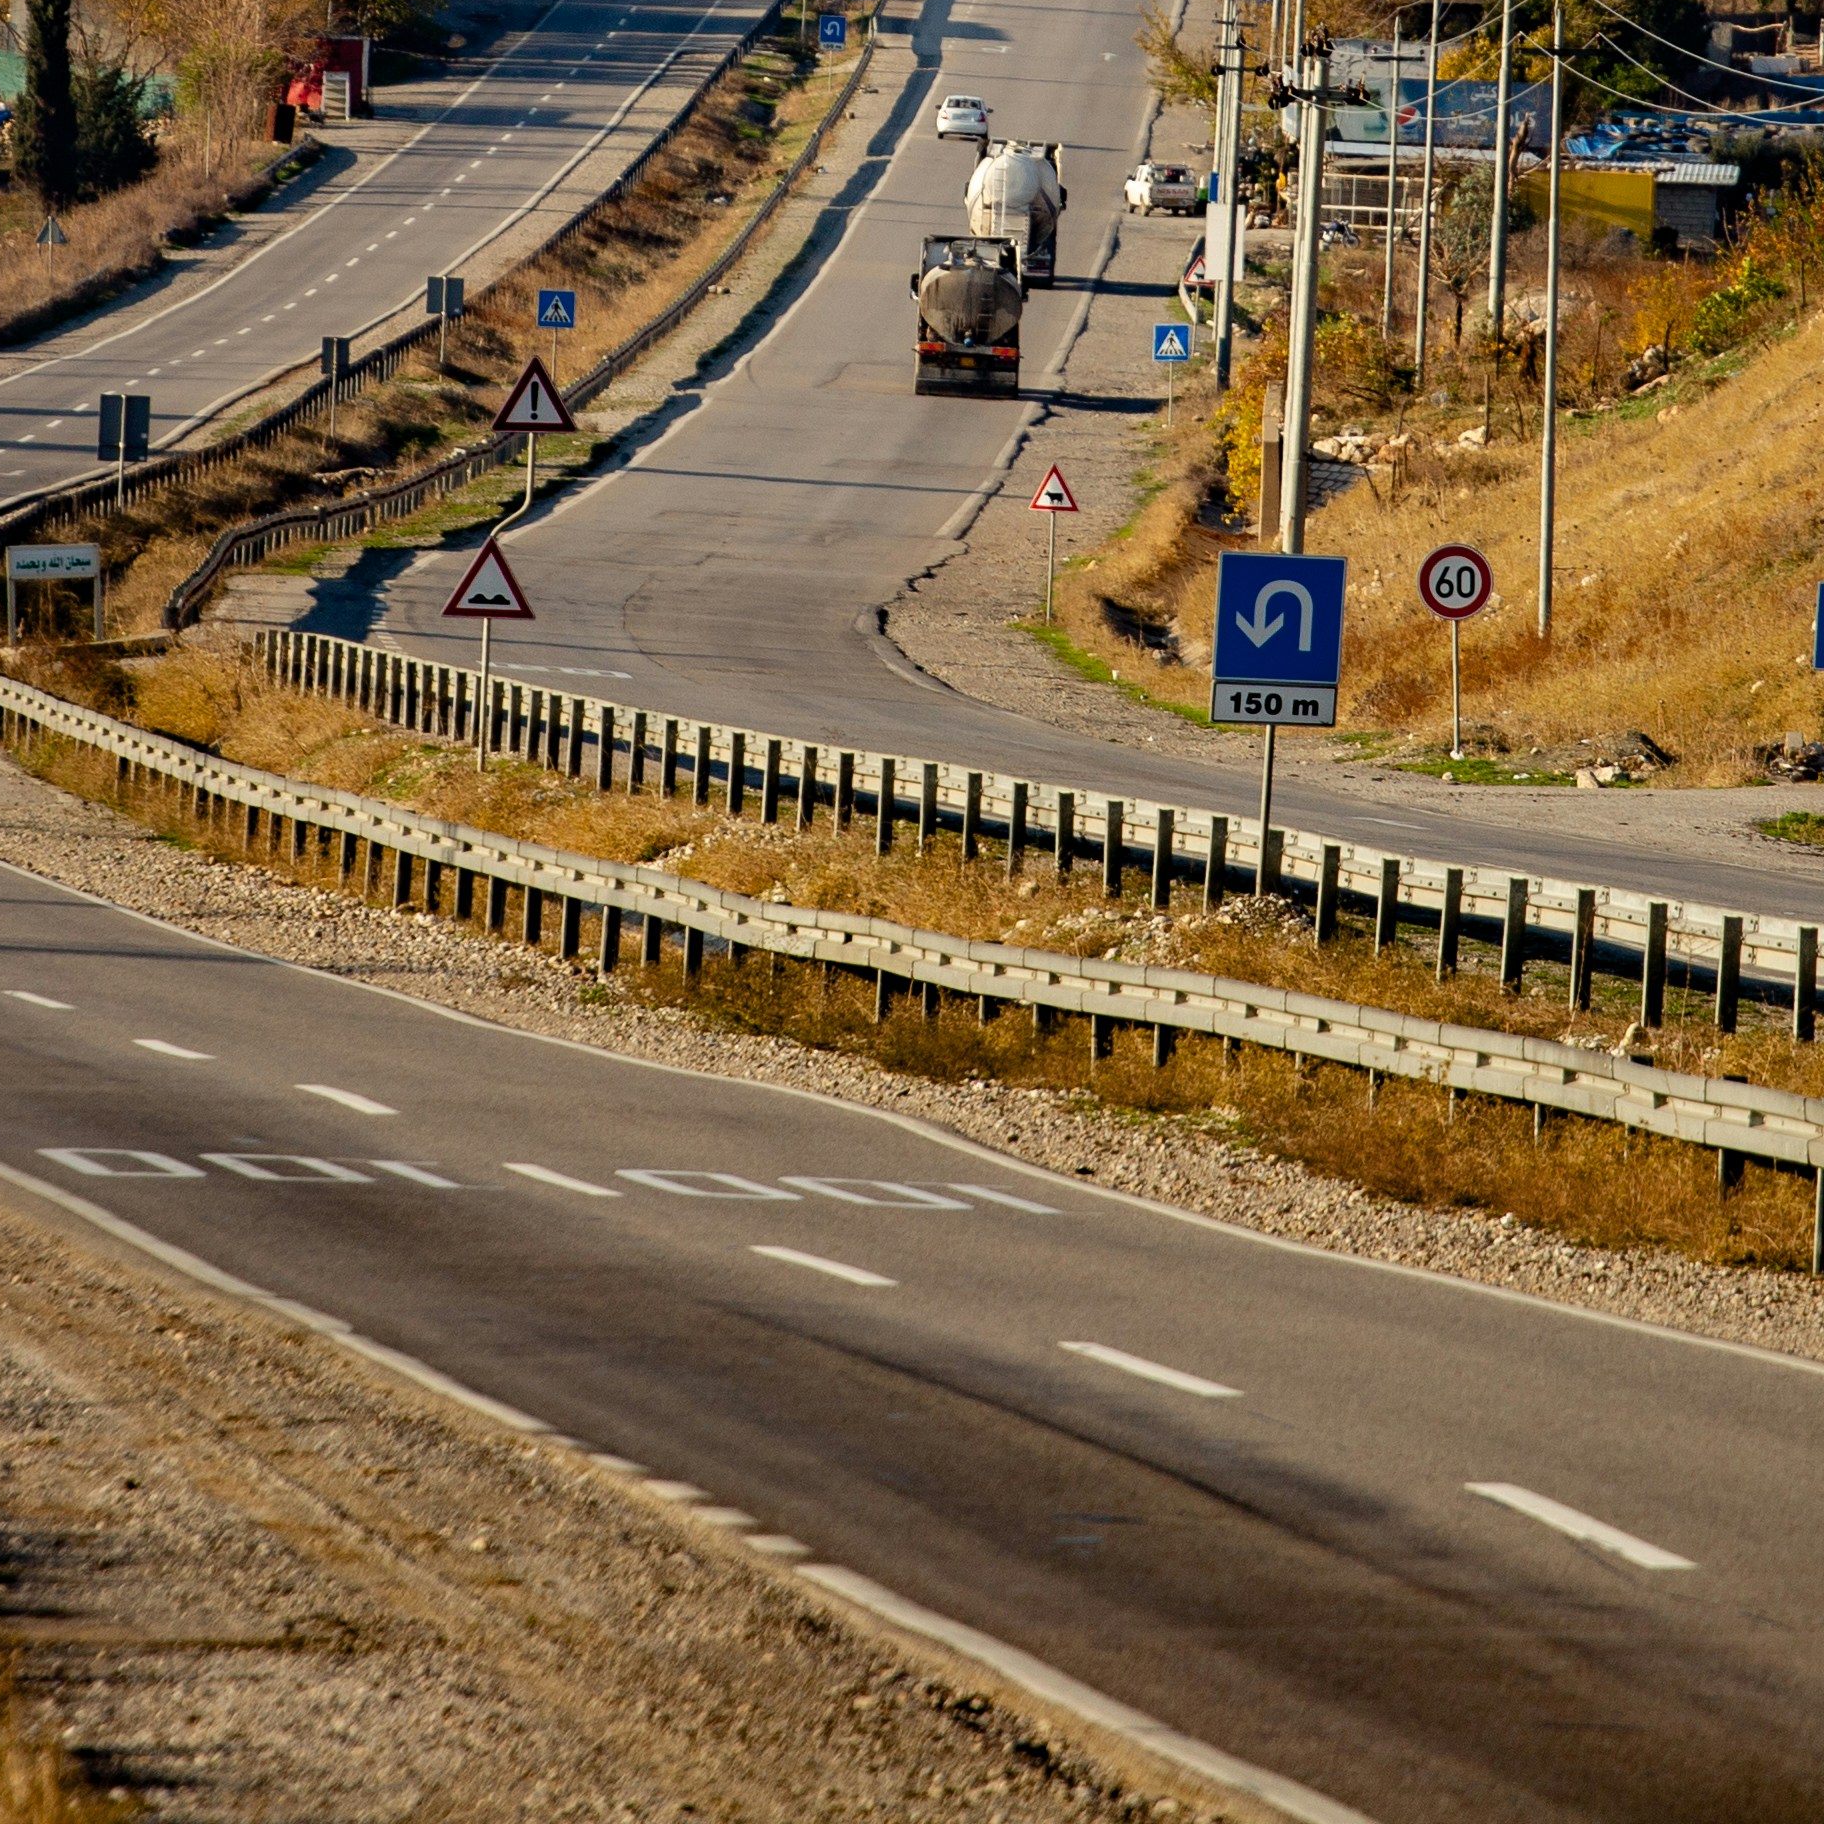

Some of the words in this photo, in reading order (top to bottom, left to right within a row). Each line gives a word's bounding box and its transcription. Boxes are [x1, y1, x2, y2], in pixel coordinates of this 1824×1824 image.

[1435, 565, 1476, 599] 60
[1229, 691, 1283, 716] 150
[1292, 698, 1319, 717] m
